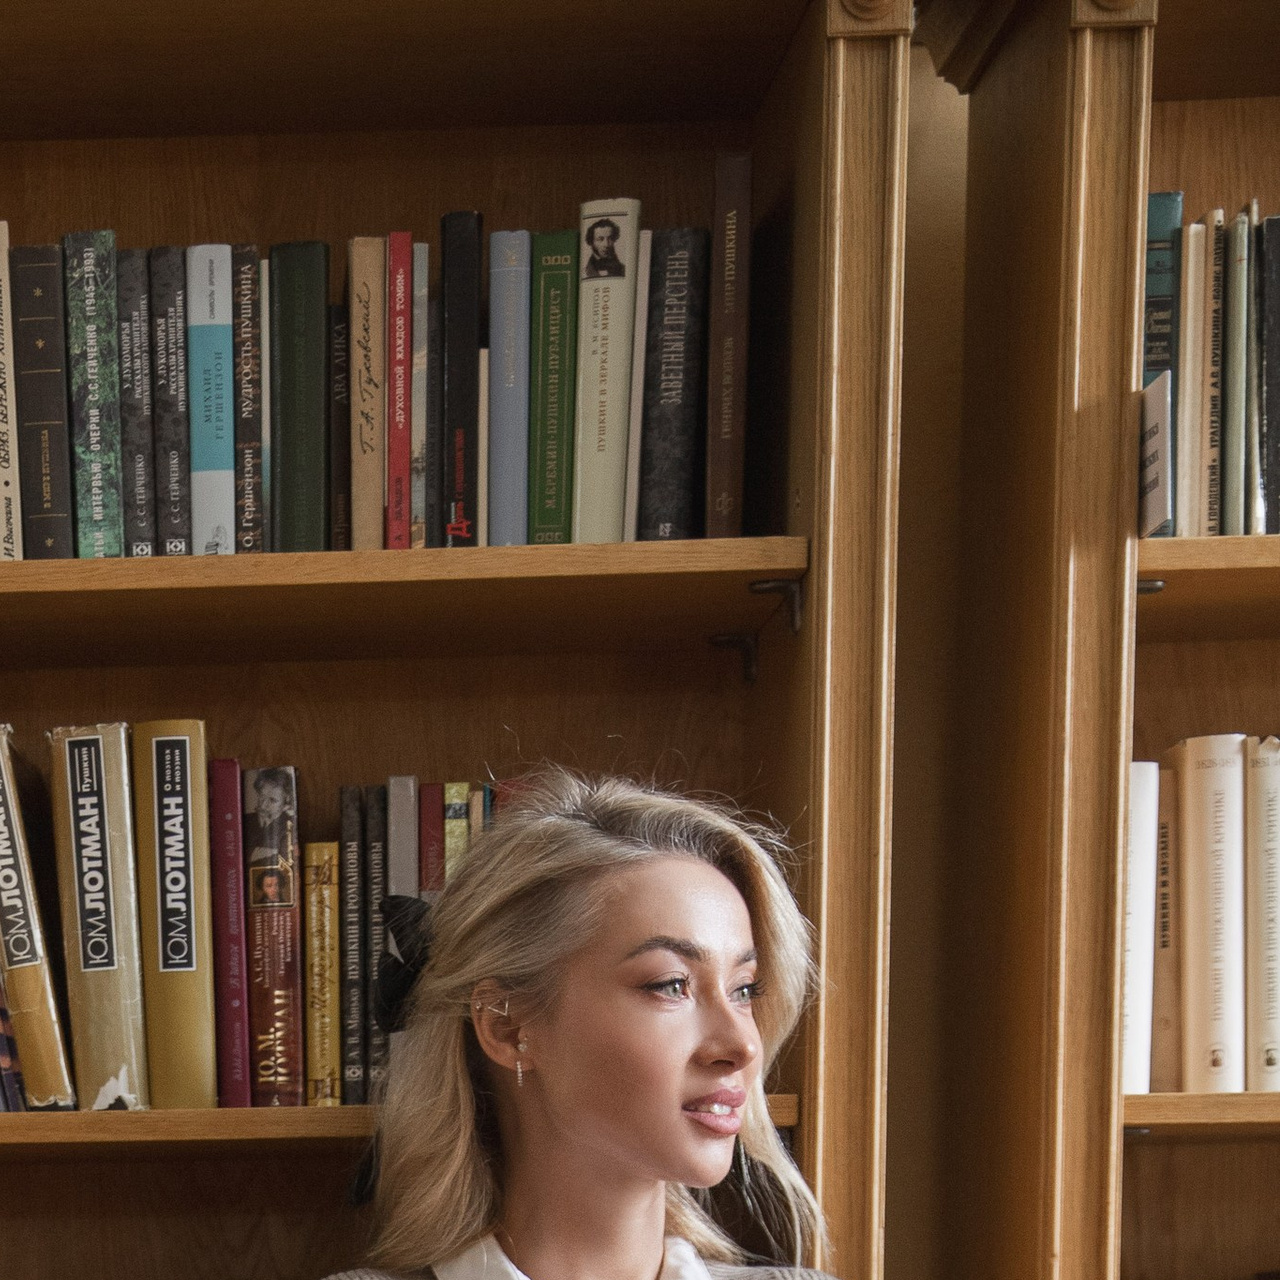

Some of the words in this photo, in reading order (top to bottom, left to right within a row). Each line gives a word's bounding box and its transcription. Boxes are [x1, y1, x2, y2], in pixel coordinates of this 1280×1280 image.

[725, 209, 737, 281] ПУШКИНА
[240, 264, 252, 337] ПУШКИНА
[600, 286, 611, 331] МИФОВ
[664, 250, 689, 325] ПЕРСТЕНЬ
[122, 322, 131, 380] ЛУКОМОРЬЯ
[157, 318, 166, 376] ЛУКОМОРЬЯ
[333, 323, 347, 367] ЛИКА
[395, 316, 404, 360] ЖАЖДОЮ
[598, 334, 610, 385] ЗЕРКАЛЕ
[1212, 308, 1221, 366] ПУШКИНА
[133, 359, 142, 399] РАССКАЗЫ
[169, 354, 178, 395] РАССКАЗЫ
[242, 341, 253, 418] МУДРОСТЬ
[334, 373, 348, 404] ДВА
[660, 329, 685, 406] ЗАВЕТНЫЙ
[203, 367, 213, 425] МИХАИЛ
[214, 351, 225, 440] ГЕРШЕНЗОН
[394, 365, 405, 429] «ДУХОВНОЙ
[1210, 395, 1220, 449] ТРАГЕДИЯ
[89, 408, 102, 451] ОЧЕРКИ
[596, 400, 607, 452] ПУШКИН
[135, 454, 145, 504] ГЕЙЧЕНКО
[169, 450, 179, 500] ГЕЙЧЕНКО
[242, 448, 254, 527] Гершензон
[1207, 464, 1218, 521] ГОРОДЕЦКИЙ
[80, 747, 93, 792] Пушкин
[174, 749, 182, 782] поэзии
[1212, 789, 1225, 844] КРИТИКЕ
[1266, 788, 1278, 843] КРИТИКЕ
[347, 841, 358, 910] РОМАНОВЫ
[1160, 822, 1169, 877] МУЗЫКЕ
[1159, 892, 1170, 949] ПУШКИН
[1211, 849, 1225, 951] ПРИЖИЗНЕННОЙ
[1265, 848, 1278, 951] ПРИЖИЗНЕННОЙ
[347, 925, 359, 980] ПУШКИН
[348, 987, 360, 1031] Манько
[1212, 968, 1224, 1021] ПУШКИН
[1265, 967, 1278, 1020] ПУШКИН
[257, 1027, 273, 1052] М.
[258, 1055, 275, 1084] Ю.
